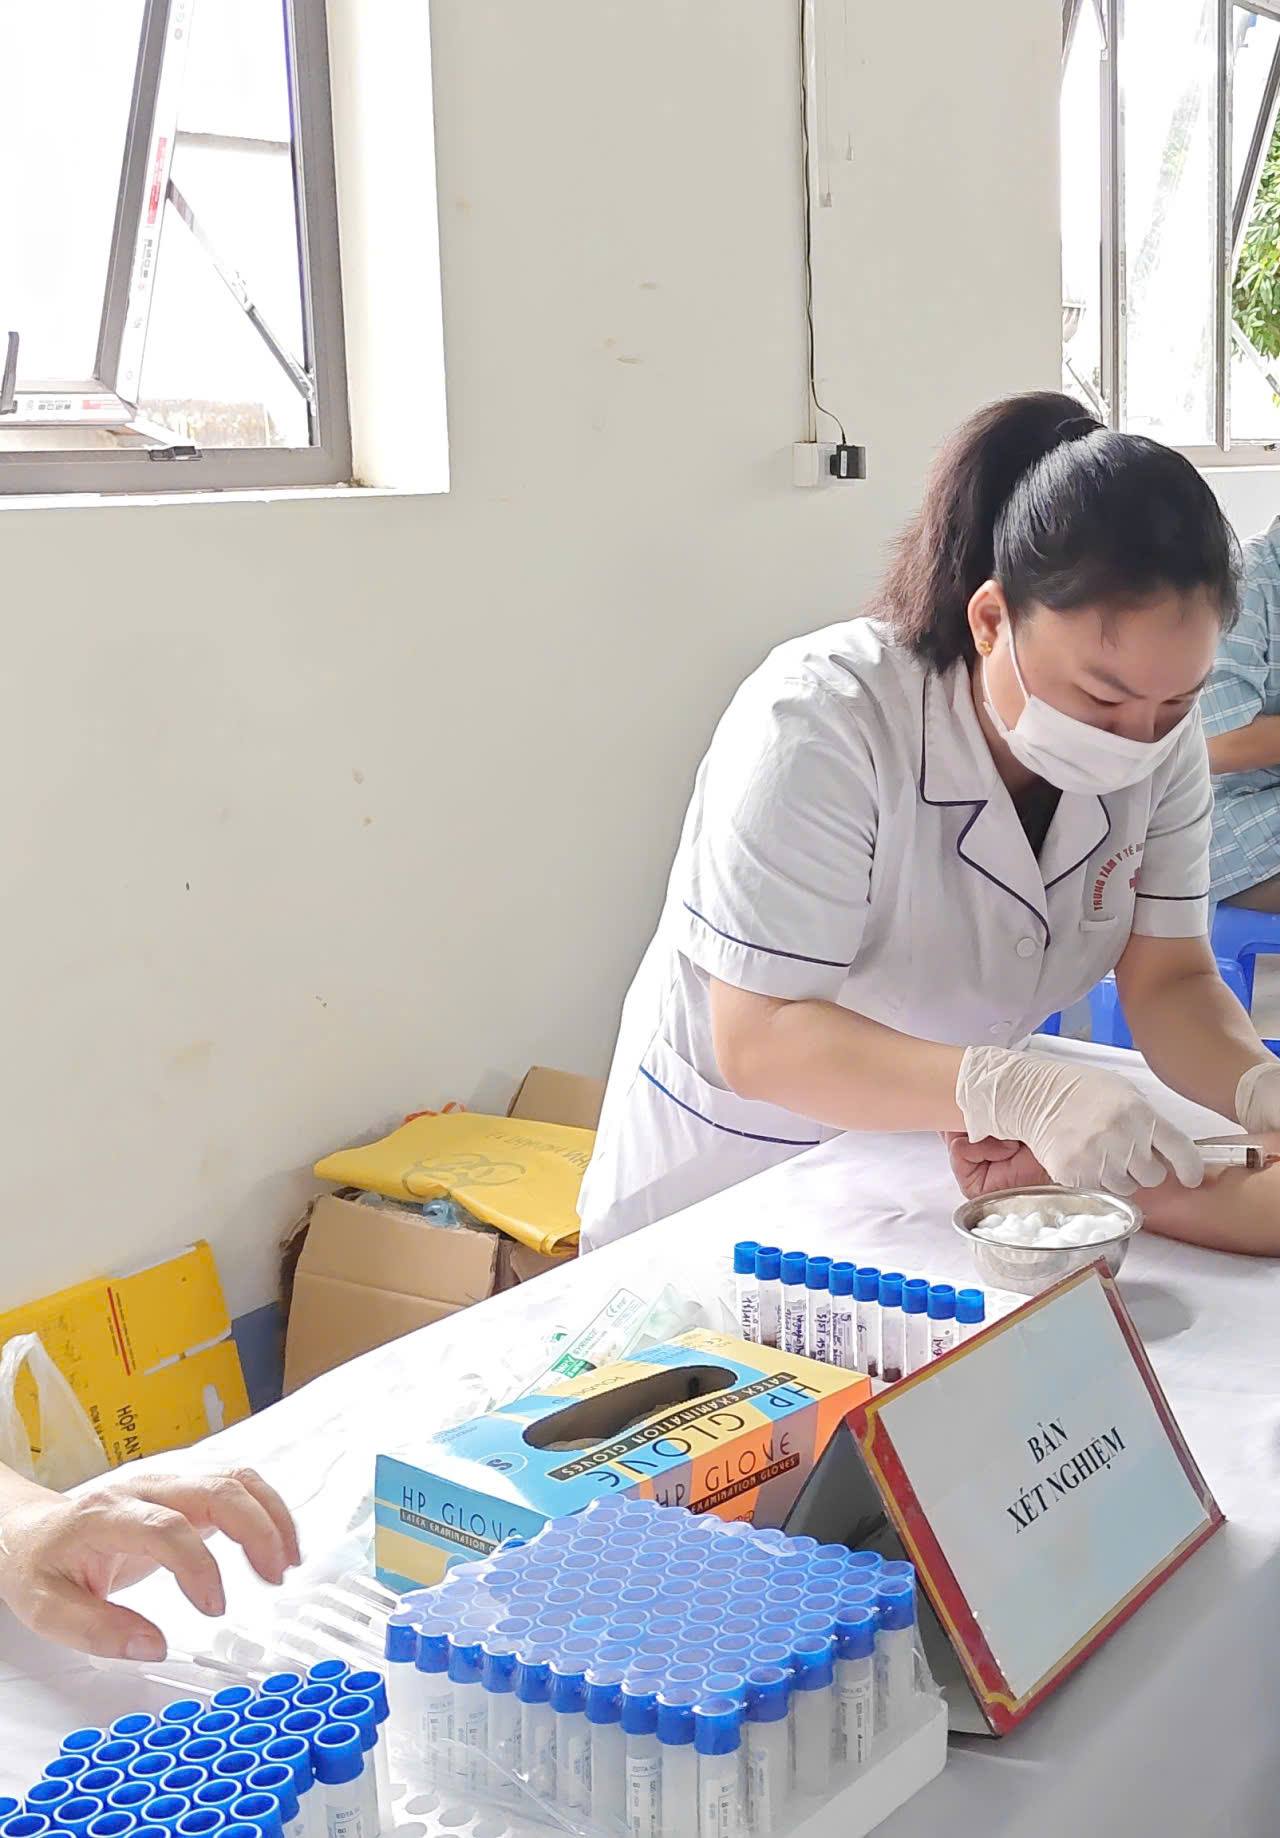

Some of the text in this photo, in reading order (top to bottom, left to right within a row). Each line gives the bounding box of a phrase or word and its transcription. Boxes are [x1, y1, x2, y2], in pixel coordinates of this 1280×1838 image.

[1093, 879, 1106, 912] TRUNG
[1115, 852, 1123, 861] Y
[561, 1374, 793, 1476] LATEX EXAMINATION GLOVES
[585, 1381, 822, 1488] HP GLOVE
[1027, 1417, 1069, 1464] BÀN
[656, 1432, 790, 1507] HP GLOVE
[691, 1457, 796, 1514] EXAMINATION GLOVES
[1046, 1426, 1127, 1502] NGHIỆM
[402, 1486, 426, 1514] HP
[401, 1511, 486, 1551] LATEX EXAMINATION
